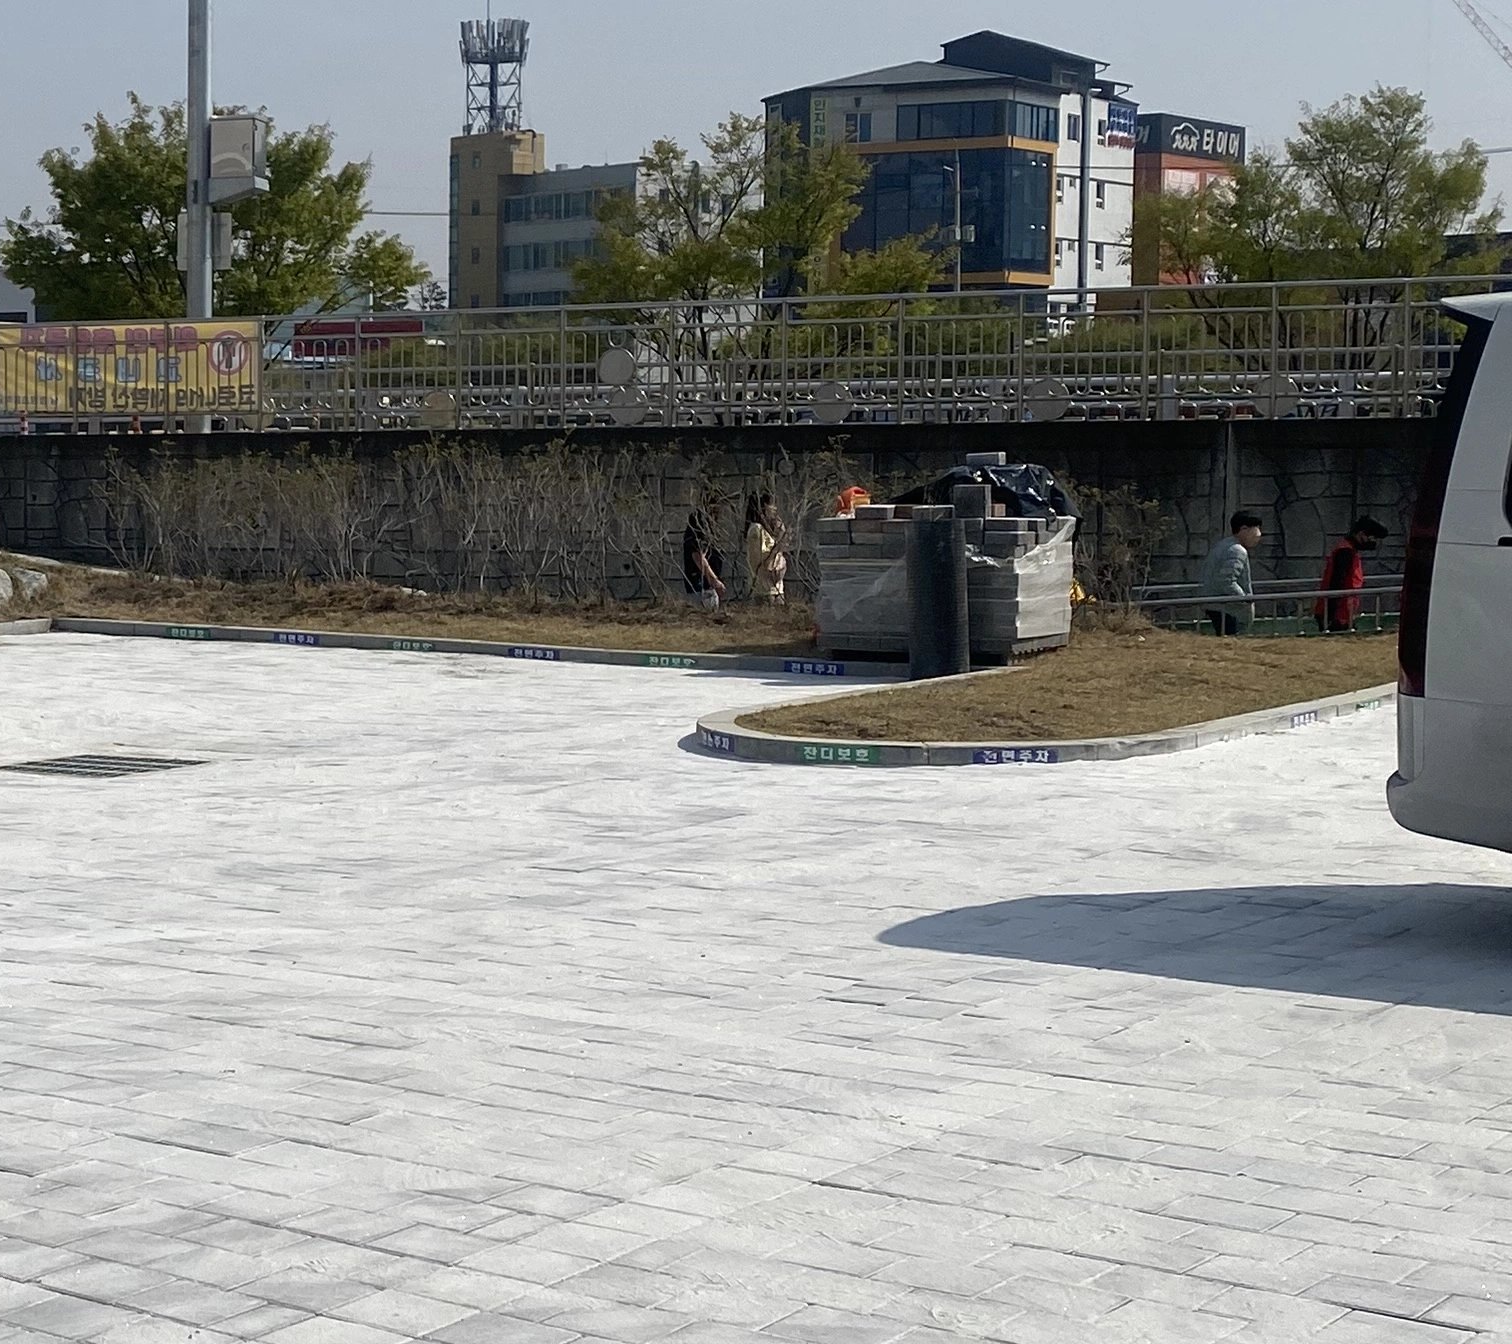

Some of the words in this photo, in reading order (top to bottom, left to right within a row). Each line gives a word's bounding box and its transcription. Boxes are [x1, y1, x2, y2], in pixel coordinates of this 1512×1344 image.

[1202, 127, 1241, 158] 타이어
[791, 662, 837, 675] 전면주차
[803, 745, 870, 762] 잔디보호
[983, 749, 1049, 763] 전면주차
